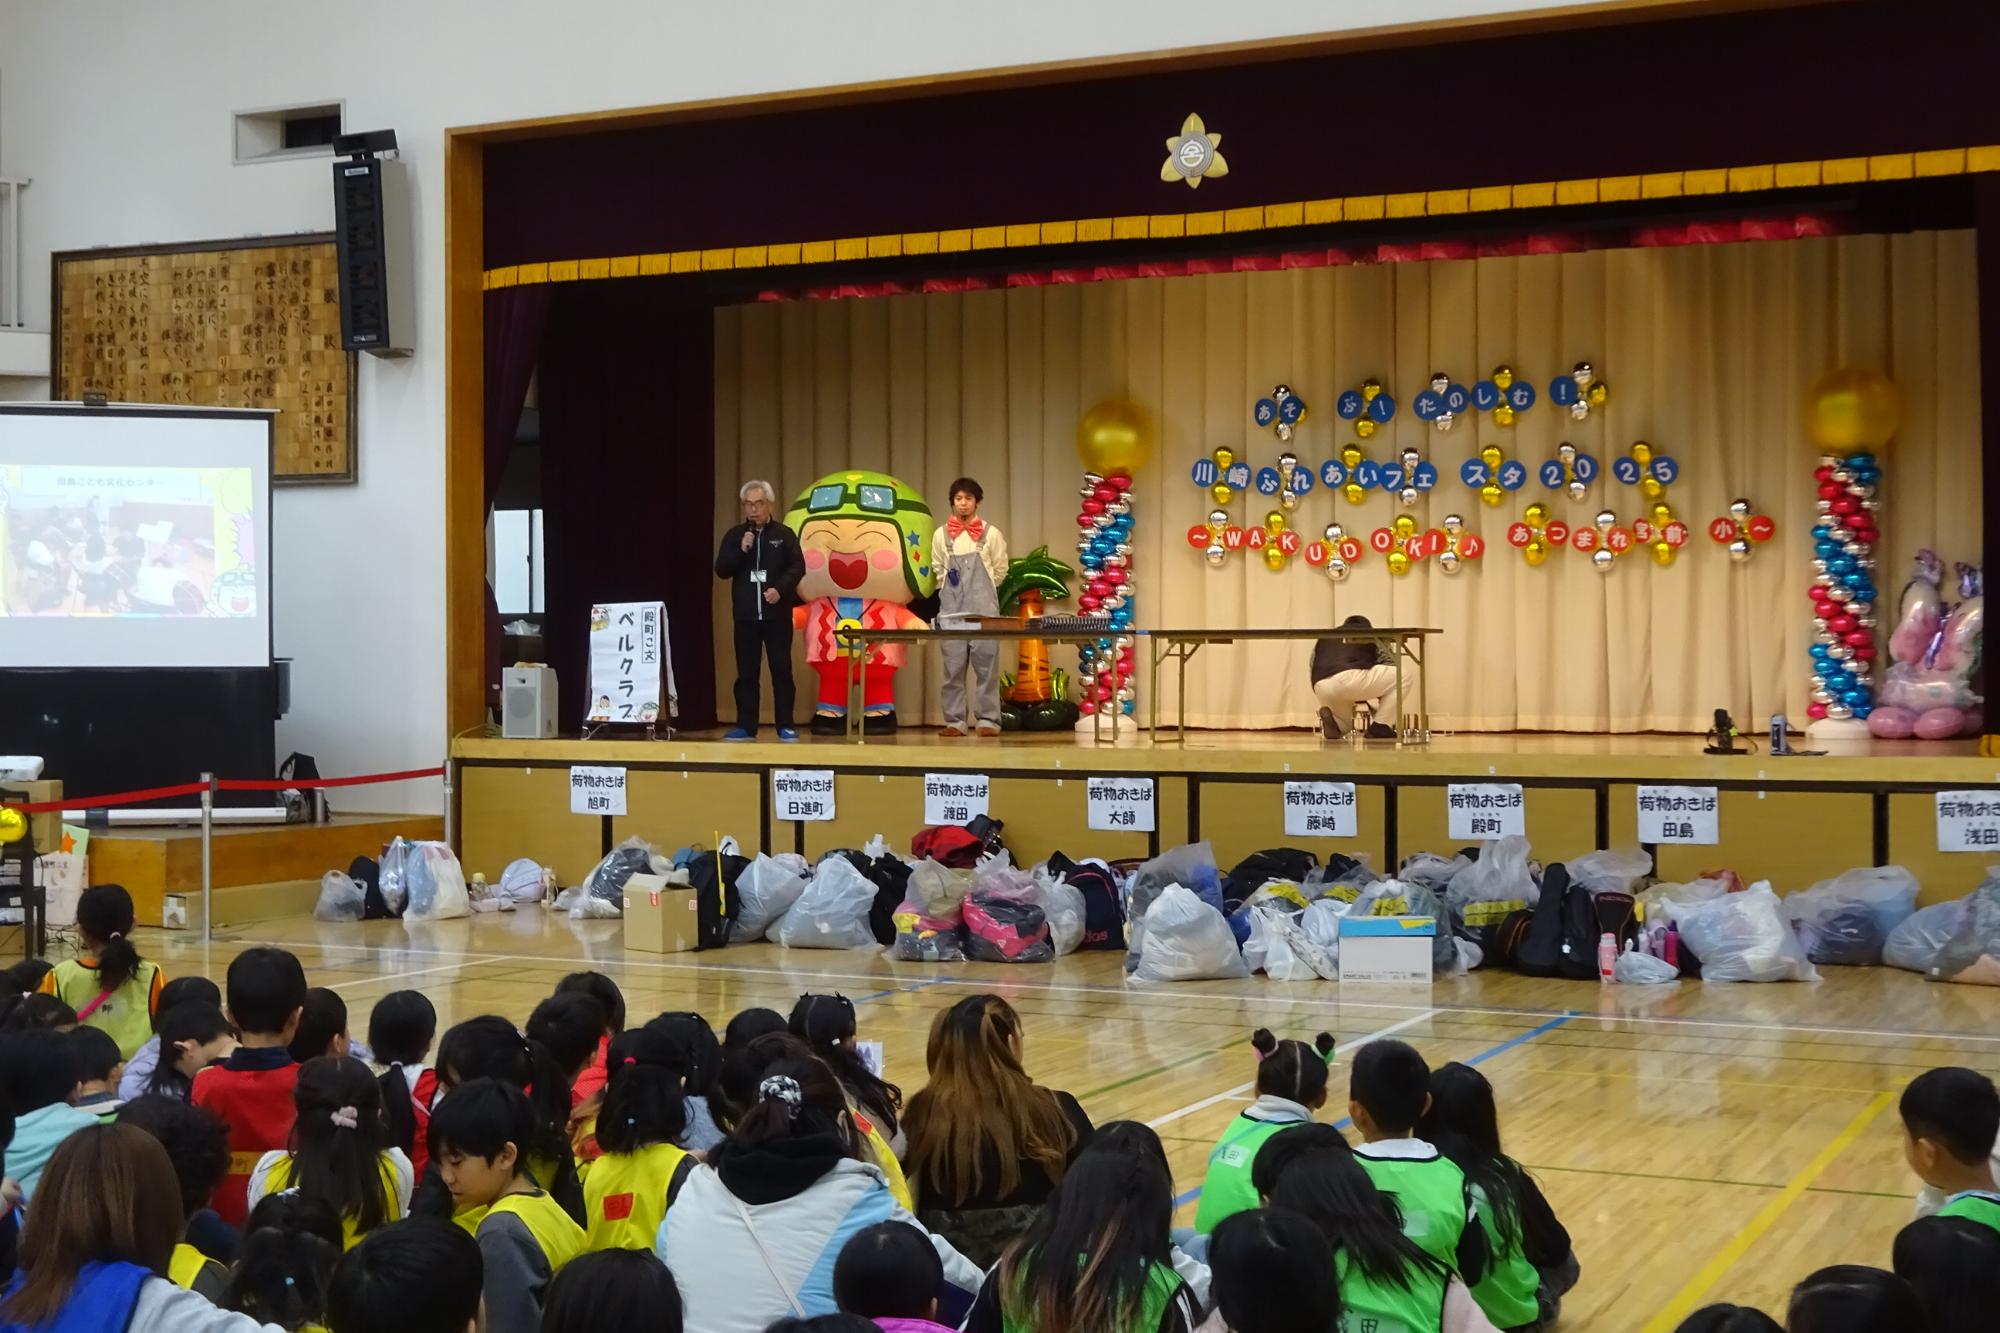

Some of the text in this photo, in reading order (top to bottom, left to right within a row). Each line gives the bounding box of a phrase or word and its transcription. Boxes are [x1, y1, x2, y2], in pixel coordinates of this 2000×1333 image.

[618, 611, 635, 719] ベルクラブ
[572, 774, 625, 788] 荷物おきば
[776, 778, 833, 792] 荷物おきば
[927, 783, 988, 798] 荷物おきば
[1089, 787, 1152, 801] 荷物おきば
[1285, 790, 1354, 806] 荷物おきば
[588, 796, 610, 810] 旭町
[788, 801, 823, 816] 日進町
[1449, 793, 1522, 809] 荷物おきば
[1639, 795, 1716, 812] 荷物おきば
[943, 806, 968, 821] 渡田
[1108, 810, 1136, 825] 大師
[1306, 815, 1336, 831] 藤崎
[1471, 818, 1503, 834] 殿町
[1663, 822, 1695, 838] 田島
[1964, 829, 1999, 845] 浅田
